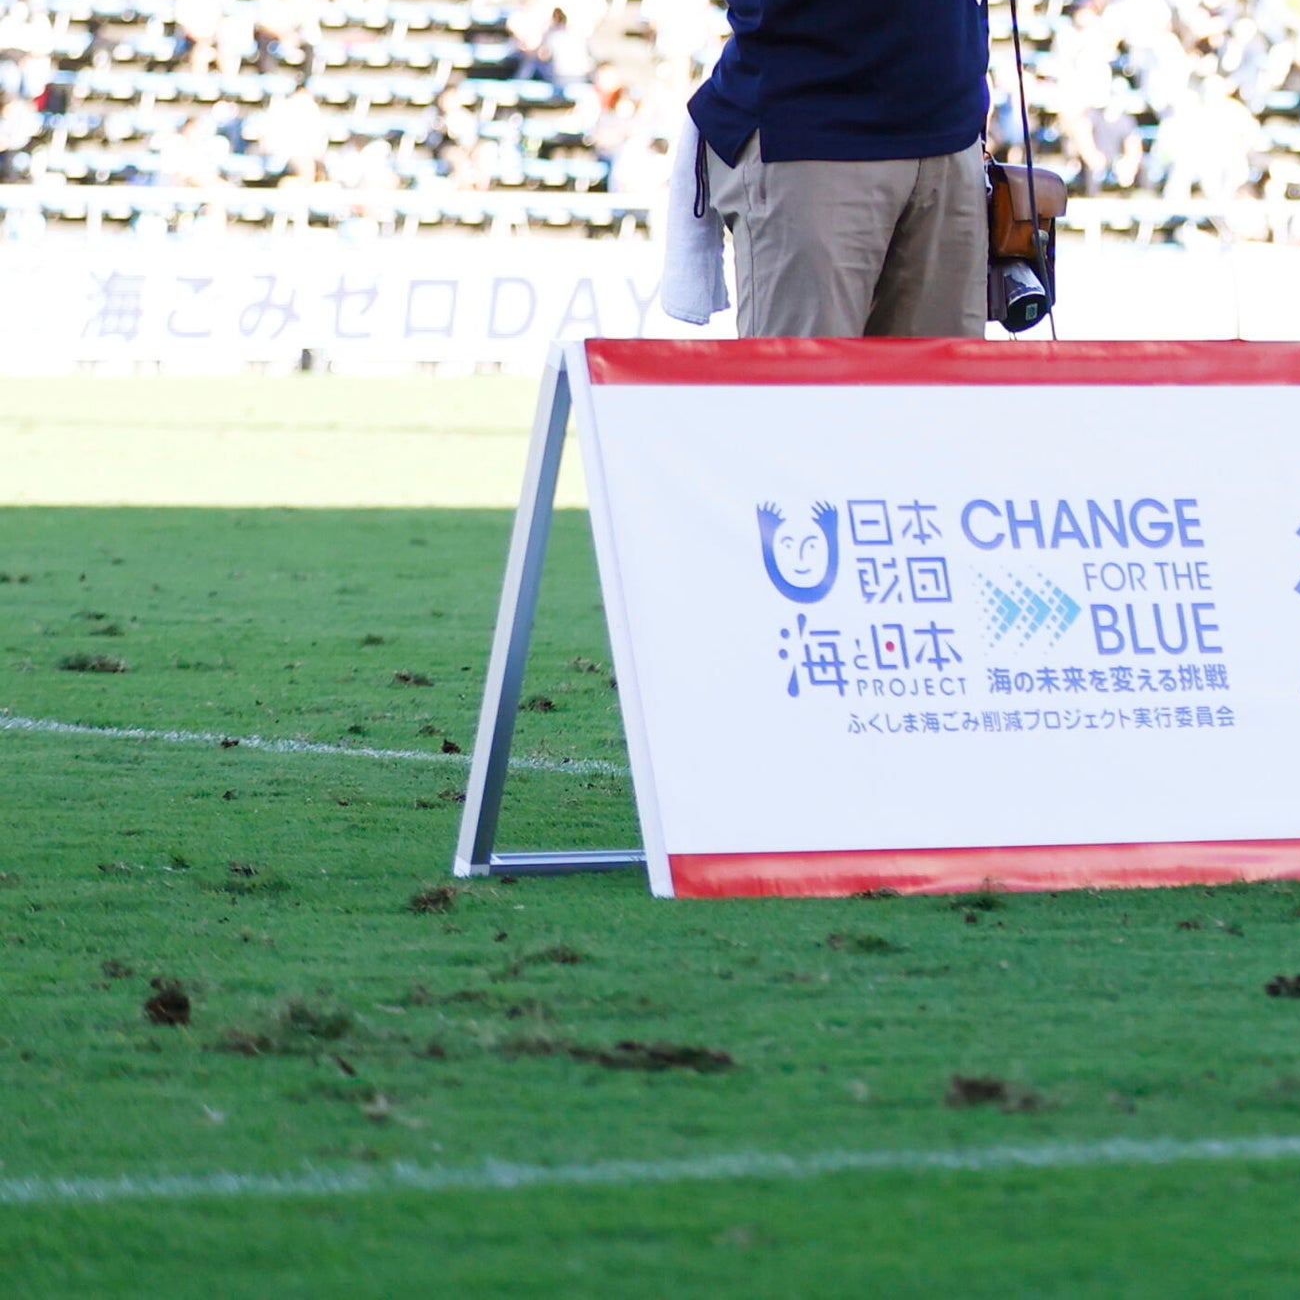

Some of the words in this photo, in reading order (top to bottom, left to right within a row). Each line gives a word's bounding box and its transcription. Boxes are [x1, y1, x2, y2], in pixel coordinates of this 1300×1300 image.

[847, 499, 942, 547] 日本
[960, 497, 1206, 550] CHANGE
[1082, 561, 1146, 591] FOR
[1154, 561, 1212, 591] THE
[1089, 602, 1224, 655] BLUE
[856, 676, 967, 697] PROJECT
[987, 664, 1230, 694] 海の未来を変える挑戦
[847, 705, 1236, 734] ふくしま海ごみ削減プロジェクト実行委員会
